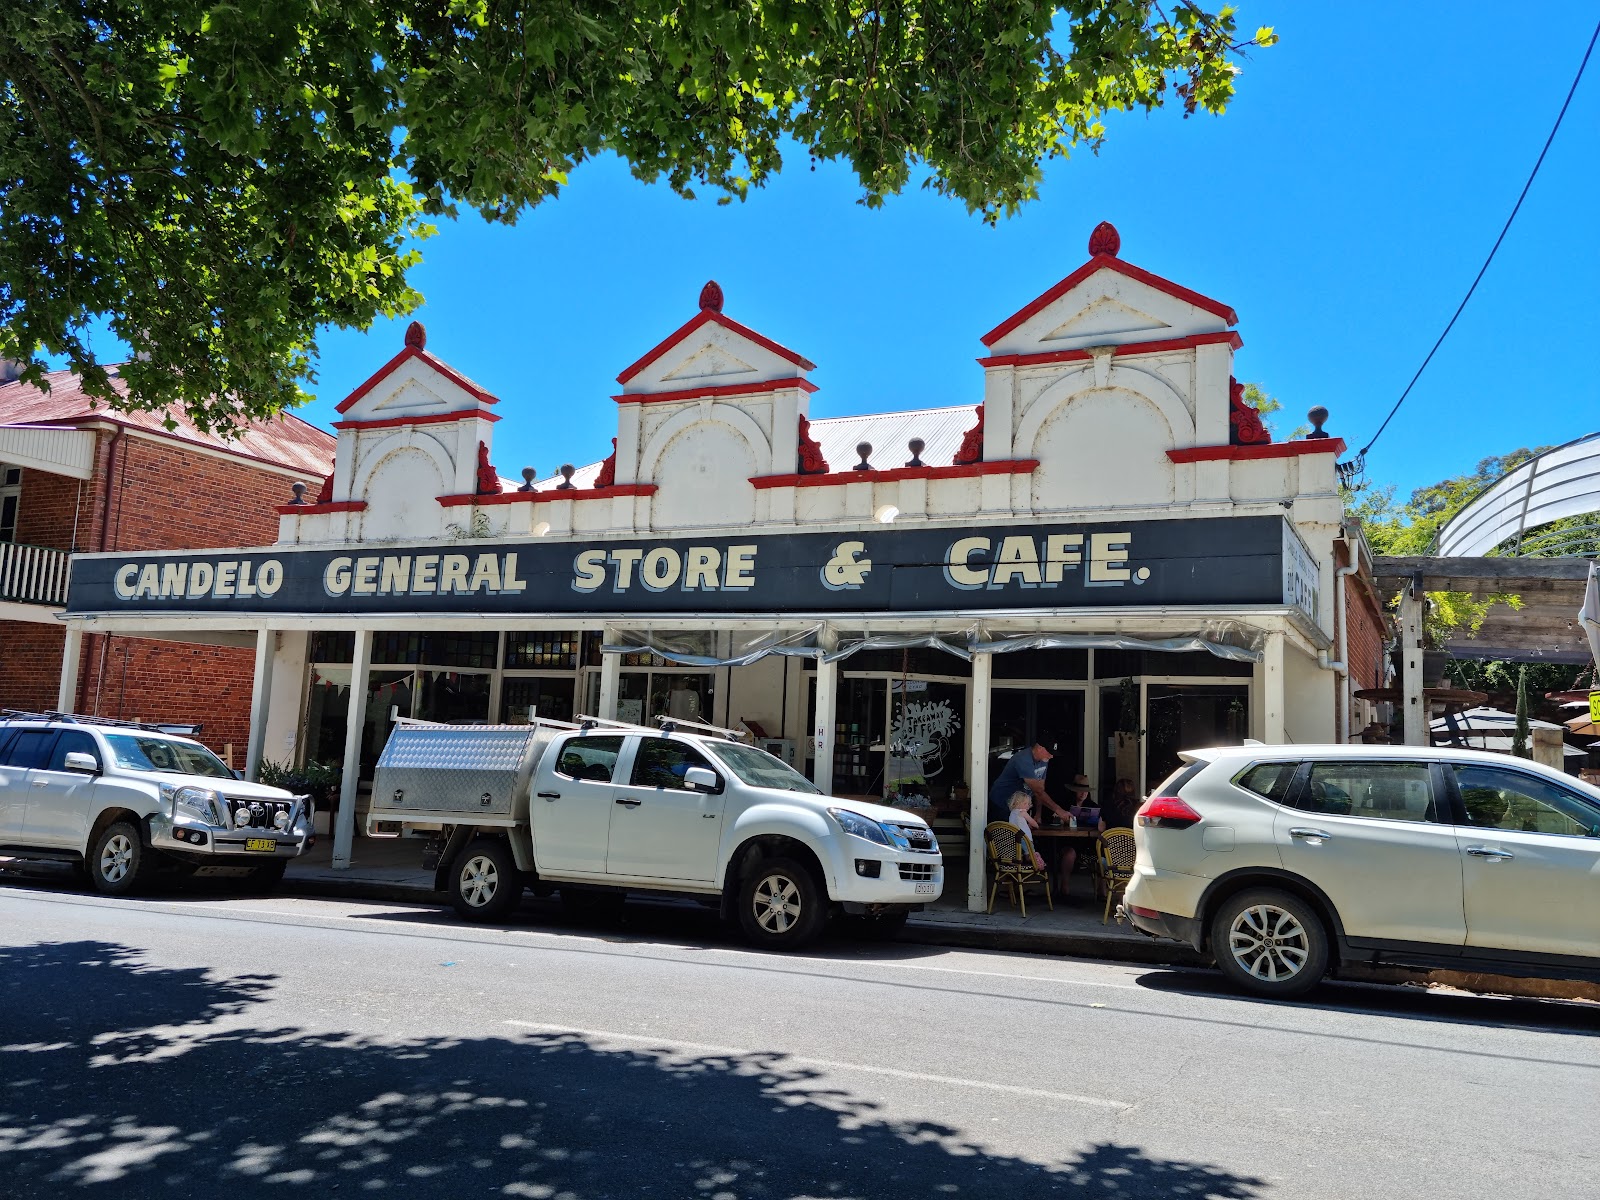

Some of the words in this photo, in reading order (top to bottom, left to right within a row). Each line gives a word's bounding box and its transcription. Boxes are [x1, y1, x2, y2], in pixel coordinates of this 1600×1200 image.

[114, 559, 284, 600] CANDELO
[323, 552, 527, 597] GENERAL
[571, 545, 758, 593] STORE
[819, 541, 871, 591] &
[943, 532, 1150, 590] CAFE.
[906, 711, 944, 726] TAKEAWAY
